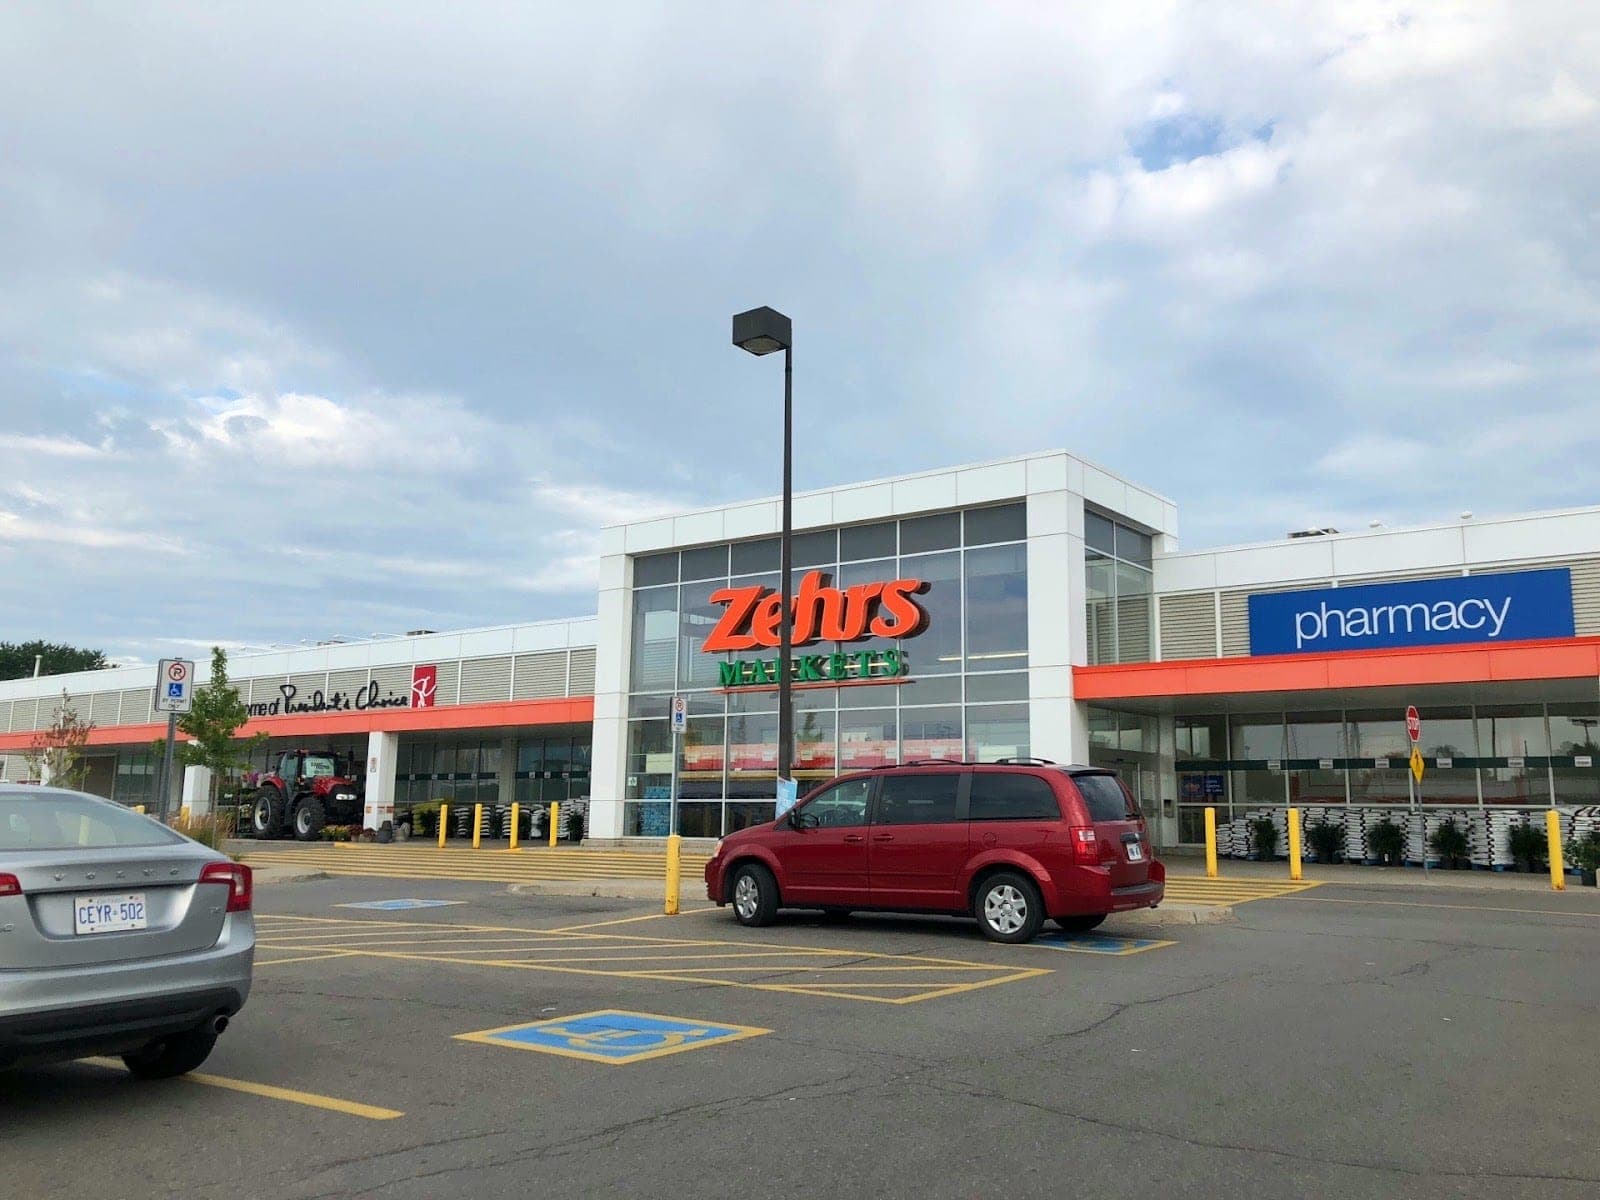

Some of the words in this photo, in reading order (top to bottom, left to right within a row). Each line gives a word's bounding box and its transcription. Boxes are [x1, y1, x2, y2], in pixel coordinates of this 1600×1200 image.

[701, 569, 922, 652] Zehrs
[1295, 596, 1512, 649] pharmacy
[269, 697, 281, 715] of
[279, 684, 350, 714] President's
[355, 679, 409, 709] Choice
[79, 904, 112, 925] CEYR
[120, 902, 144, 921] 502
